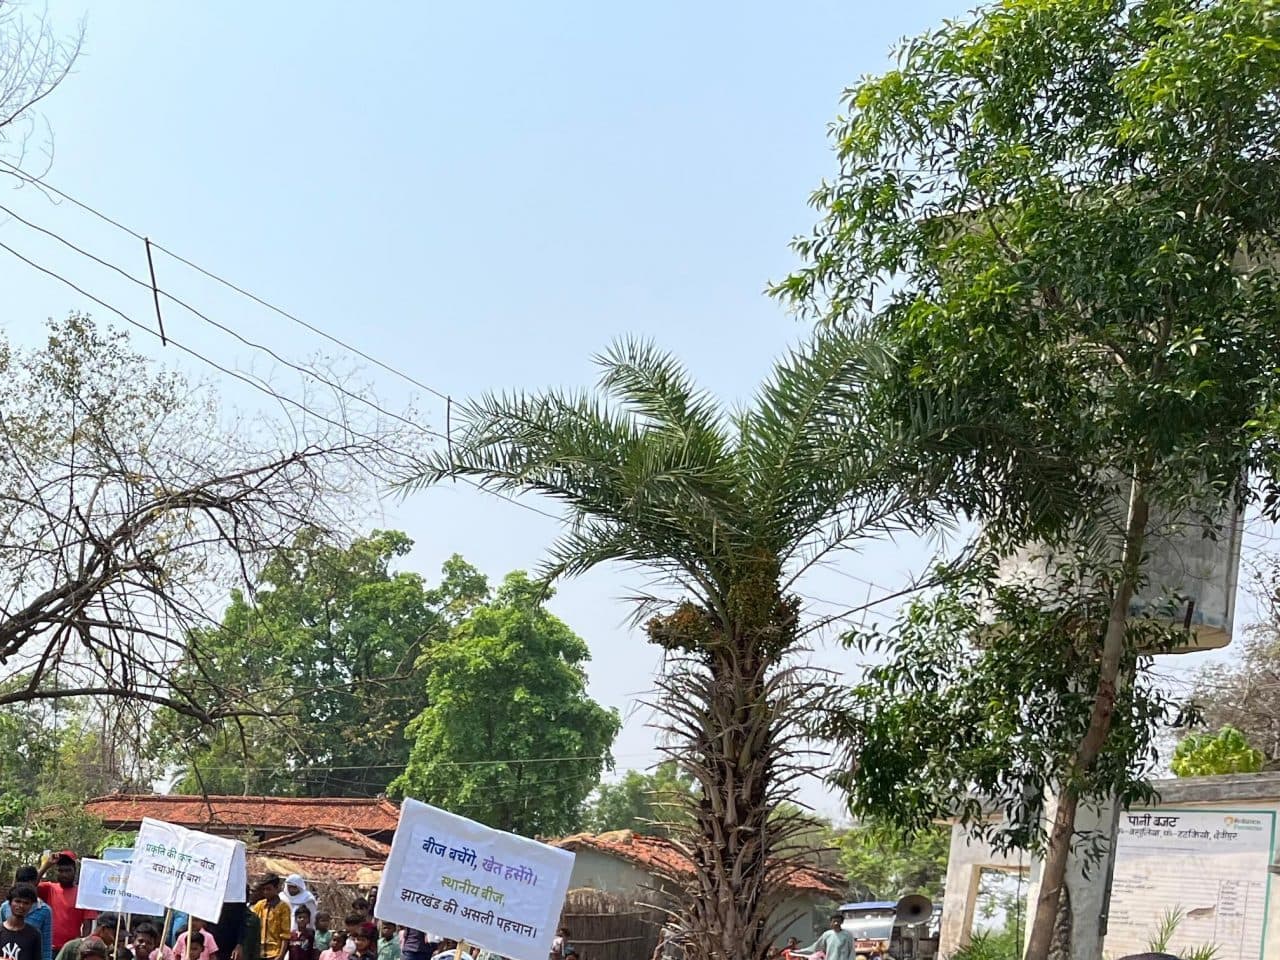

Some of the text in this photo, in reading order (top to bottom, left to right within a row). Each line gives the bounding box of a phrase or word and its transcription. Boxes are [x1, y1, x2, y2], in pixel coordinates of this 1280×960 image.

[1127, 813, 1180, 828] पानी बजट
[200, 857, 216, 871] बीज
[422, 837, 447, 858] बीज
[448, 846, 478, 871] बचेंगे,
[481, 855, 503, 875] खेत
[441, 875, 481, 897] स्थानीय
[401, 888, 538, 939] झारखंड की असली पहचान।
